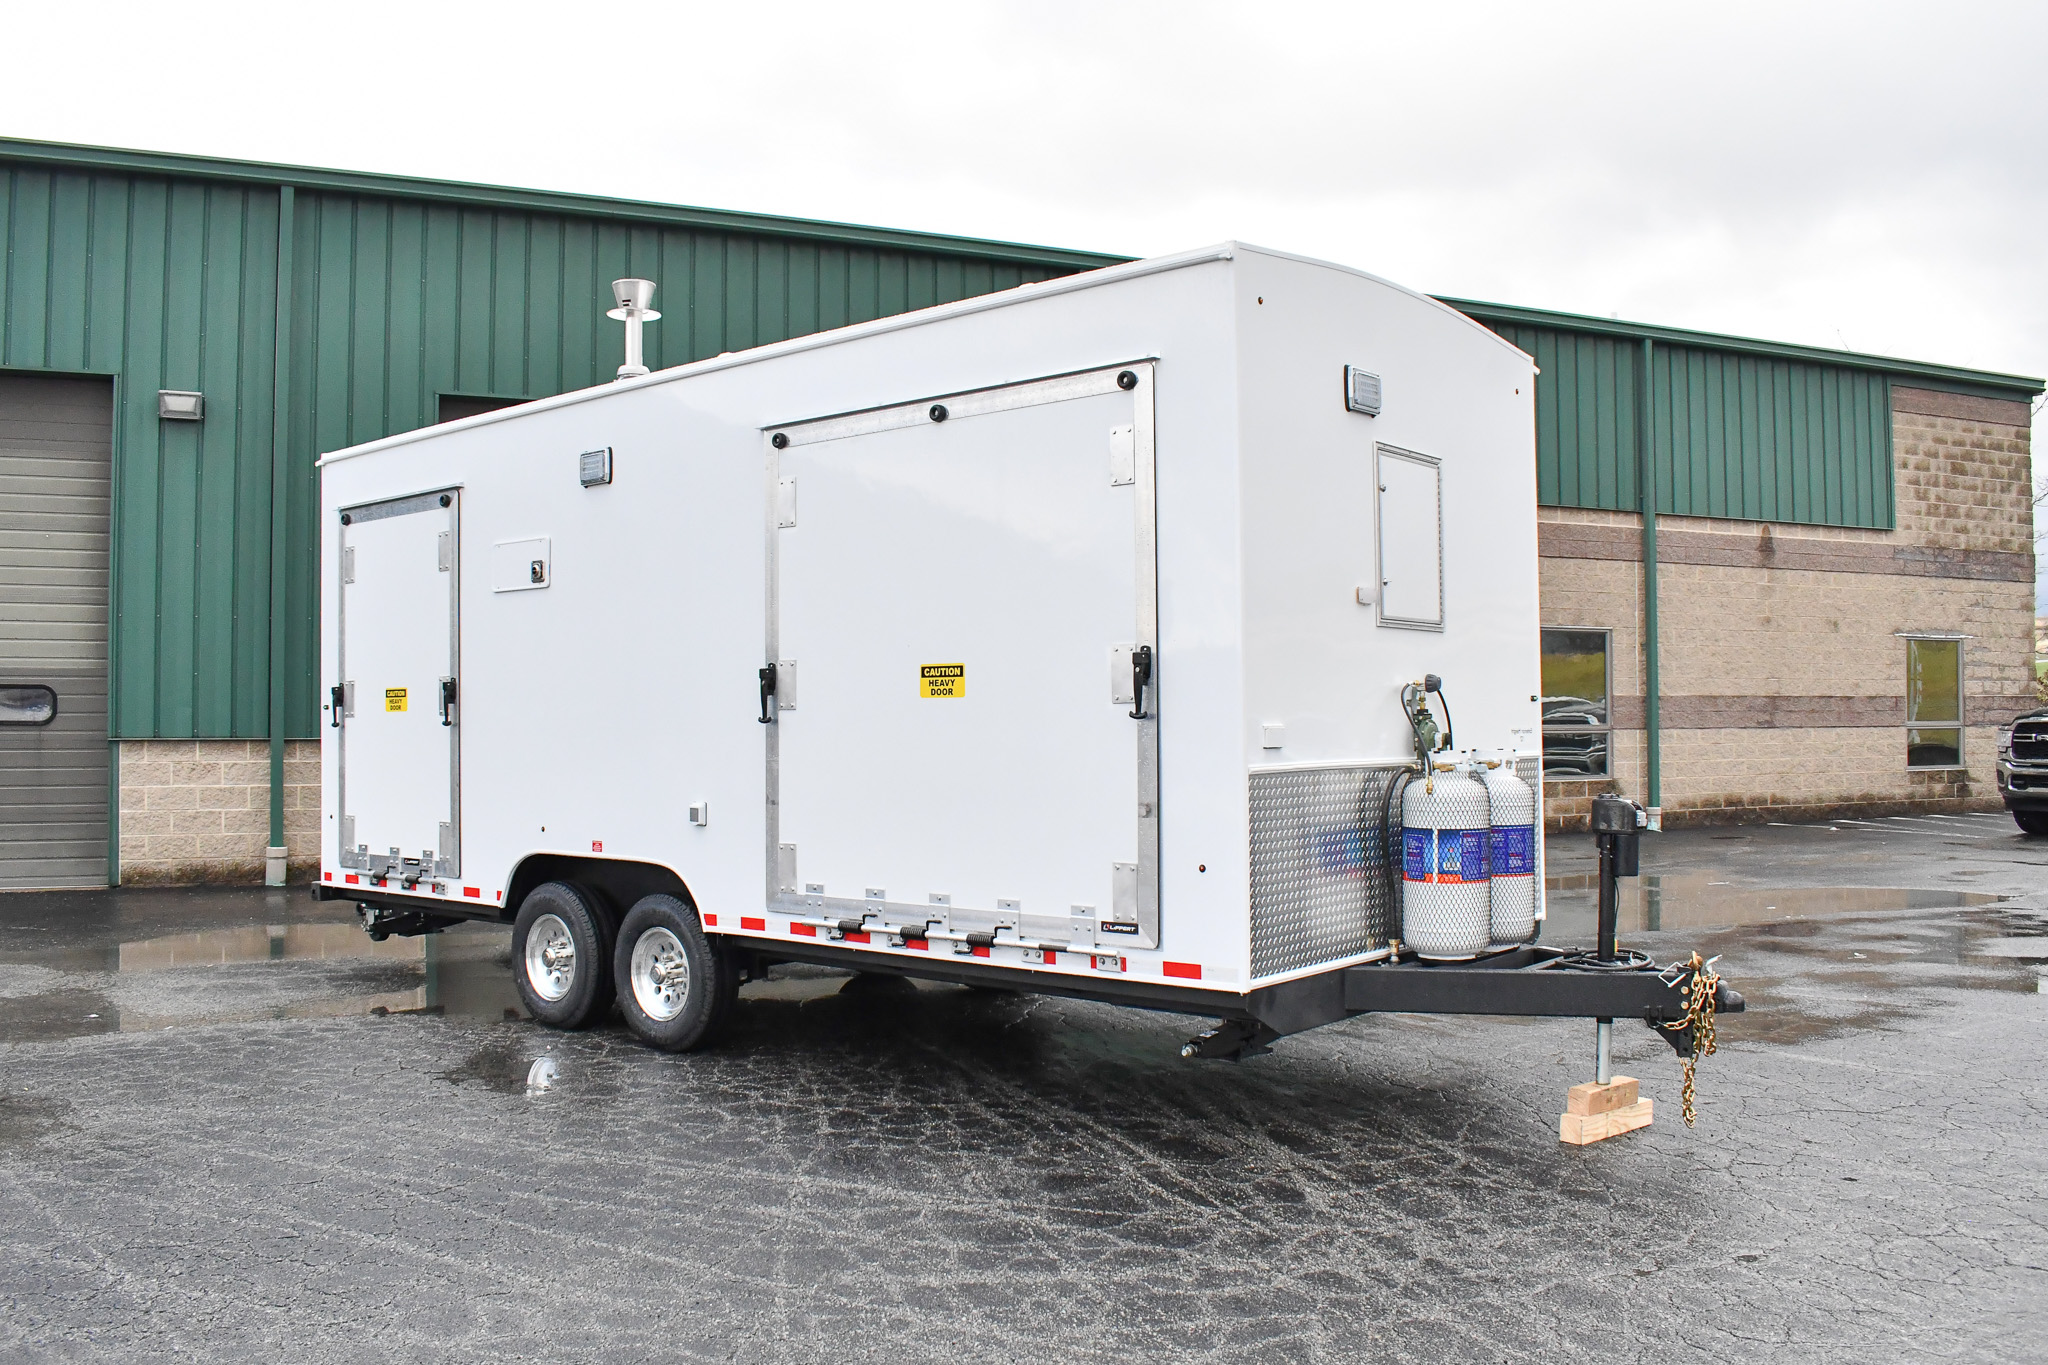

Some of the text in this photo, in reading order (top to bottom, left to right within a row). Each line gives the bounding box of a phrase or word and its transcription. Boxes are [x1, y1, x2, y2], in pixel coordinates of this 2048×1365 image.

[924, 667, 961, 677] CAUTION
[928, 679, 955, 687] HEAVY
[930, 688, 953, 696] DOOR
